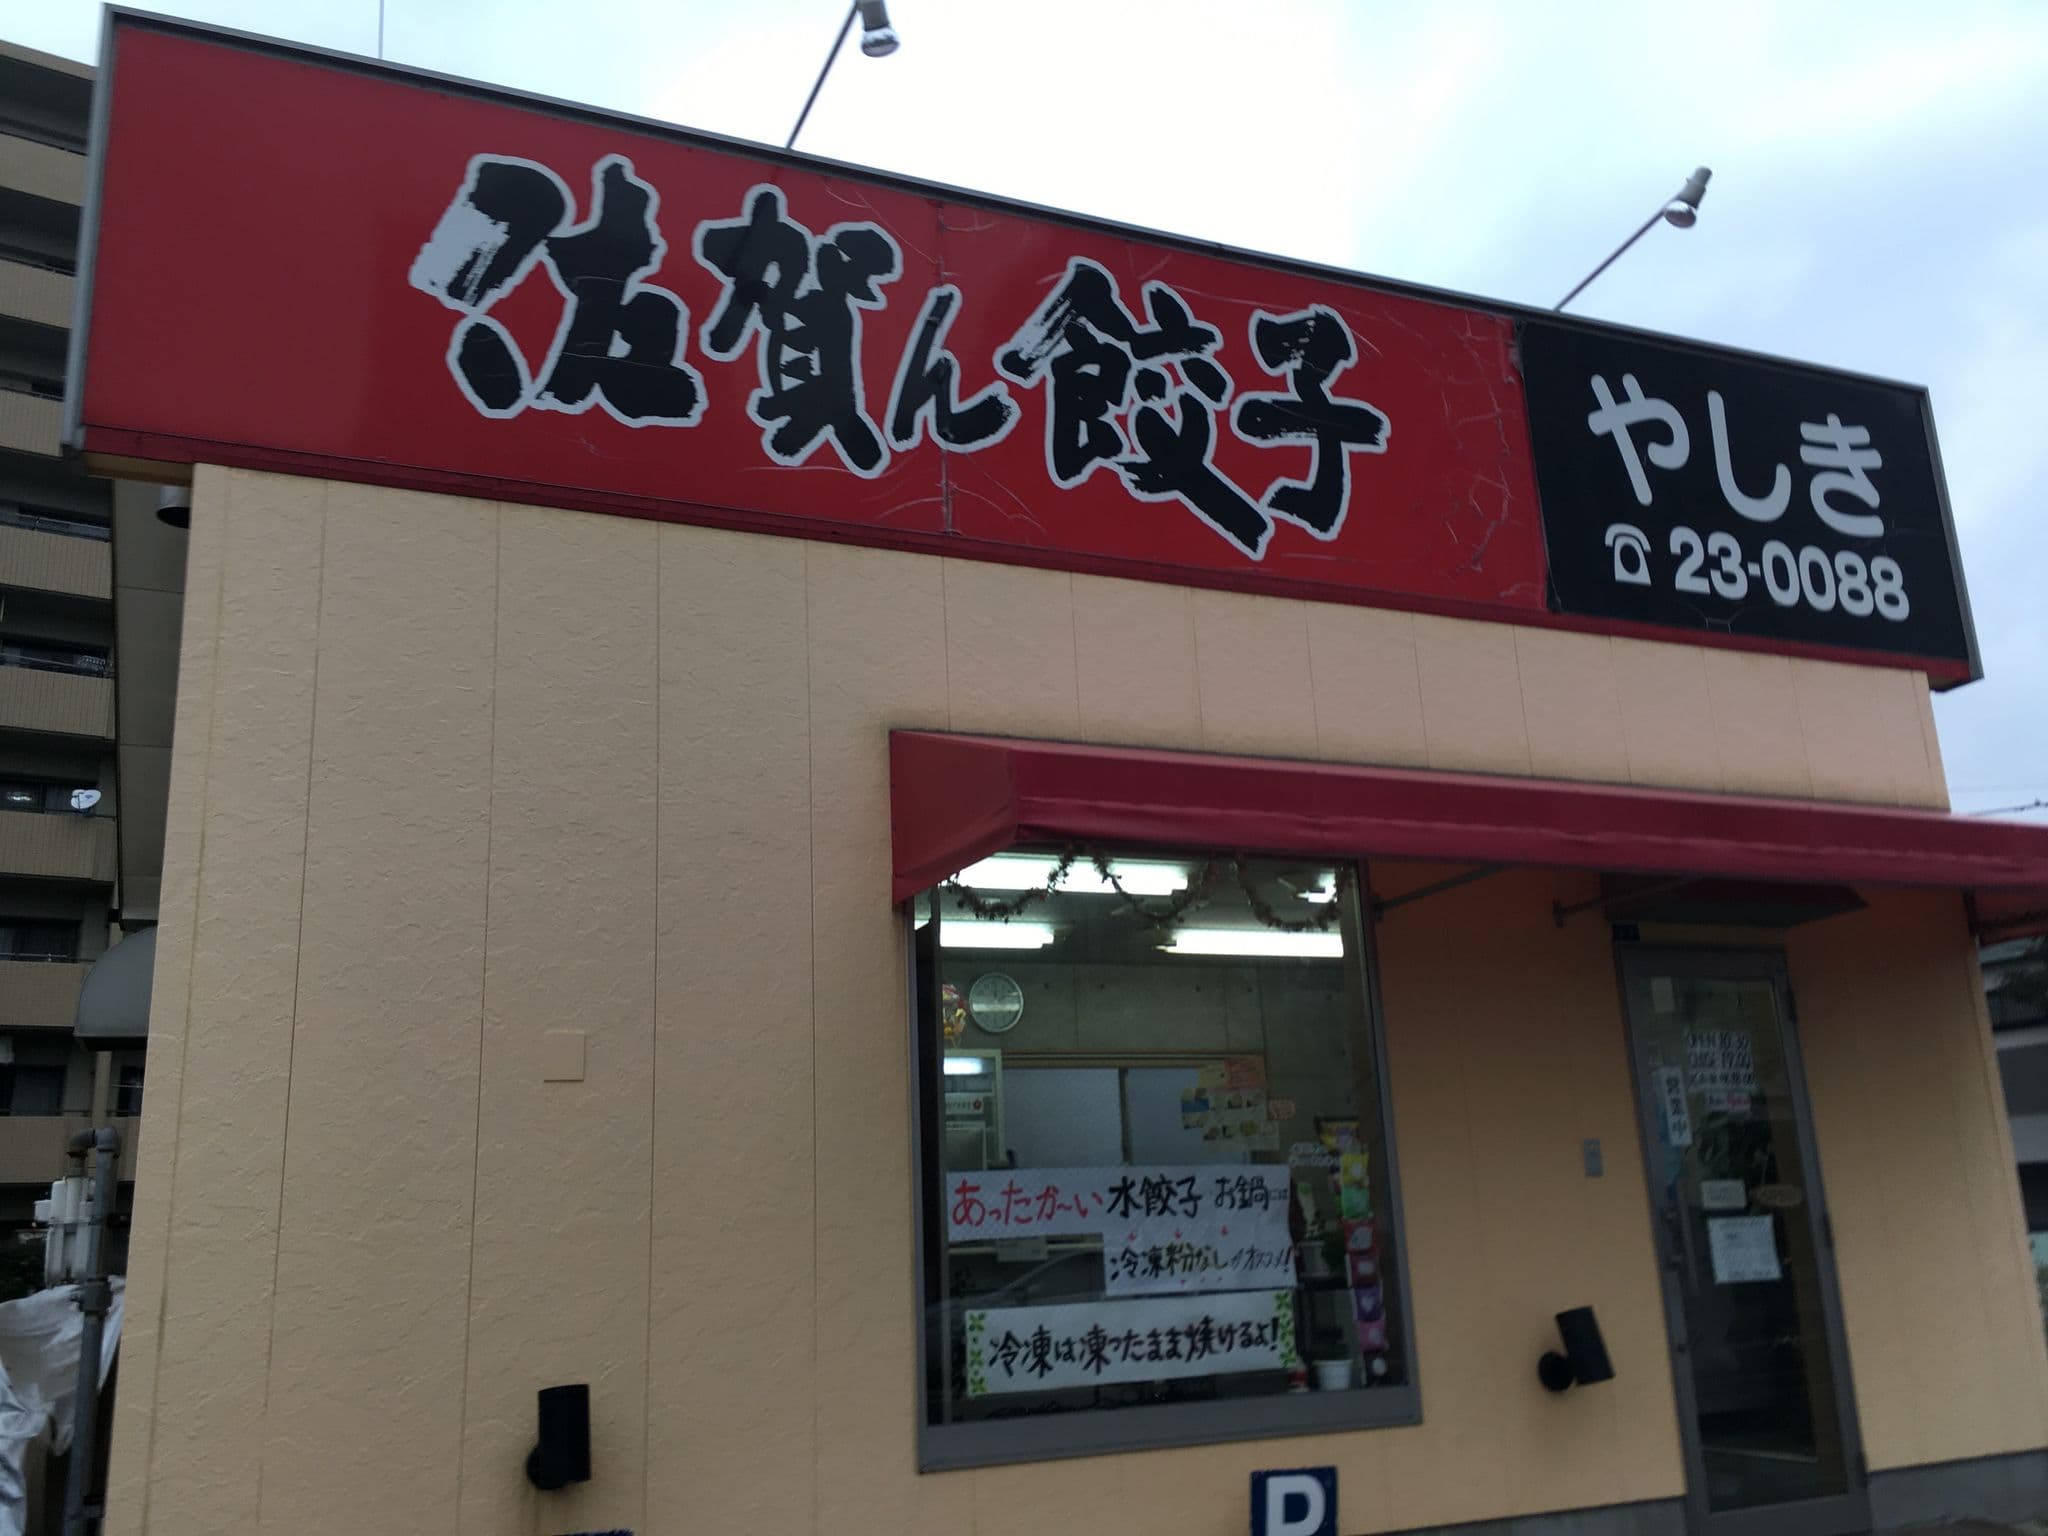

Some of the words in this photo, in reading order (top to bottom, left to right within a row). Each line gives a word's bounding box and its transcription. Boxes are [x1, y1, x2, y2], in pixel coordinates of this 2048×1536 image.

[409, 153, 1391, 561] 佐賀ん餃子
[1588, 373, 1884, 537] やしき
[1670, 526, 1909, 621] 23-0088
[1265, 1474, 1326, 1536] P
